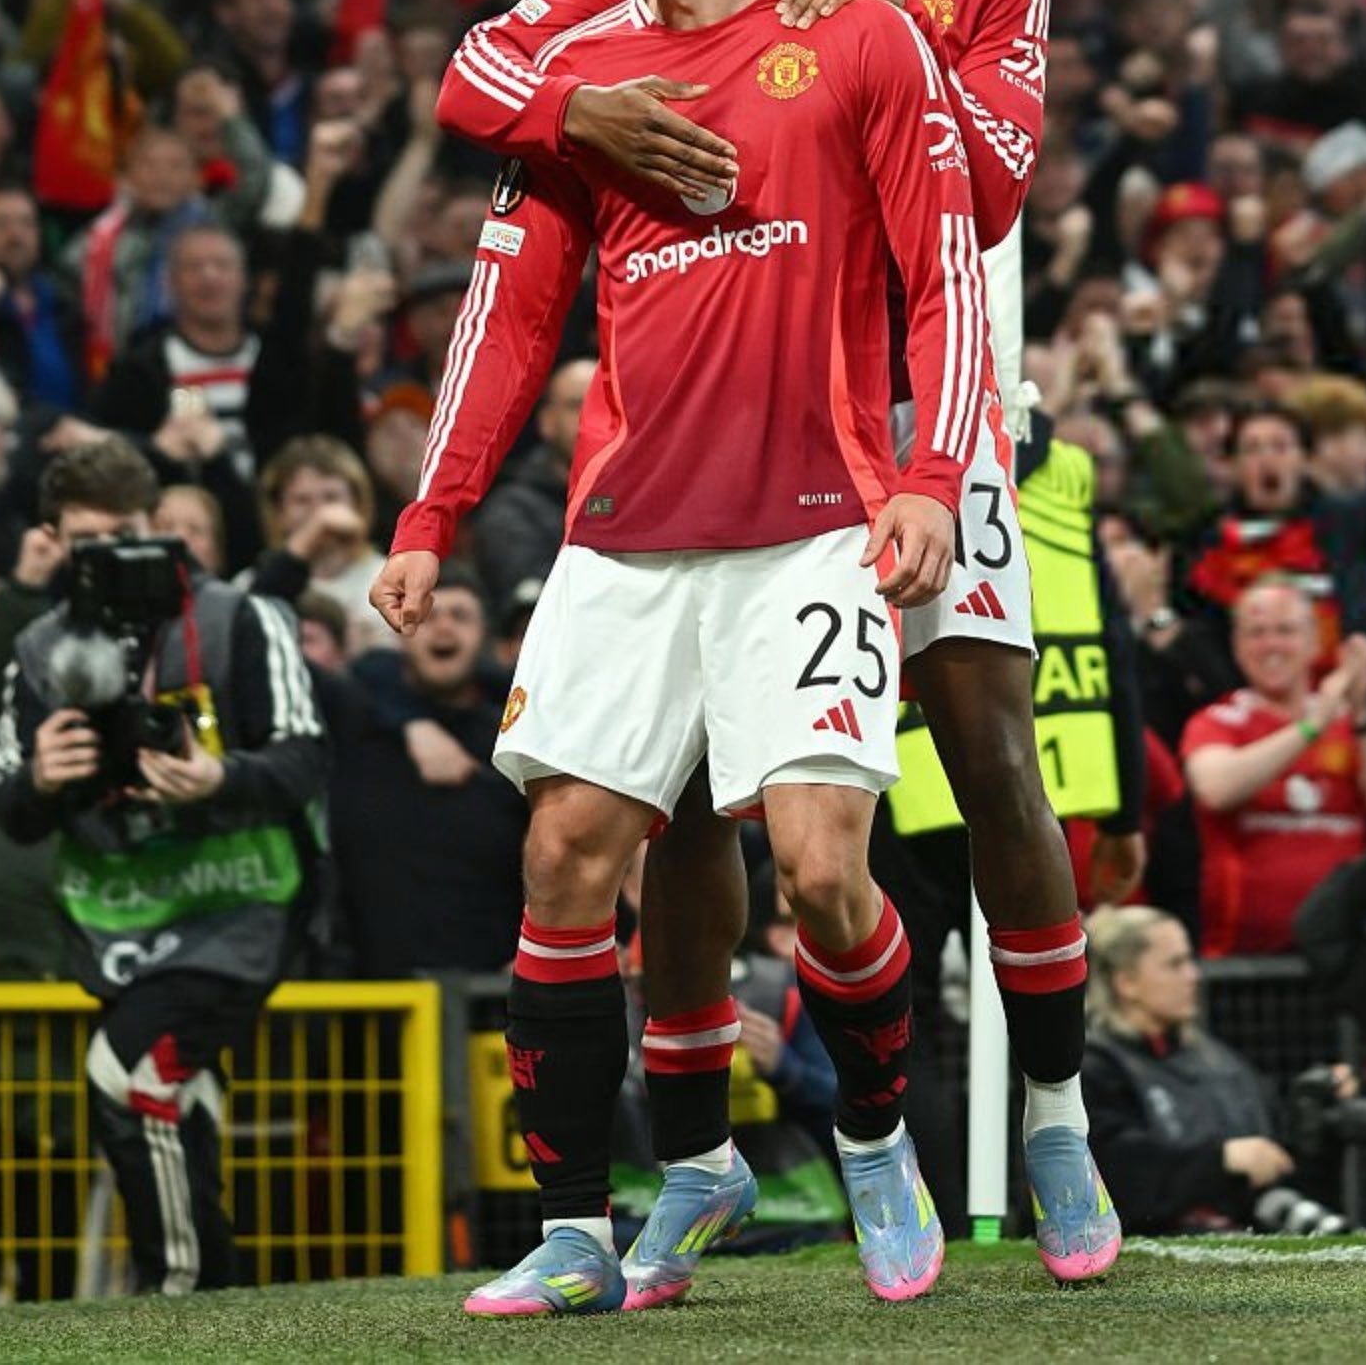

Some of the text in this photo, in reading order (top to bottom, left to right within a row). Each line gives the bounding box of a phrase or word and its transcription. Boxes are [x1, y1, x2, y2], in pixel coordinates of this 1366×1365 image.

[626, 220, 808, 284] Snapdragon
[795, 601, 888, 699] 25
[1035, 644, 1110, 704] AR
